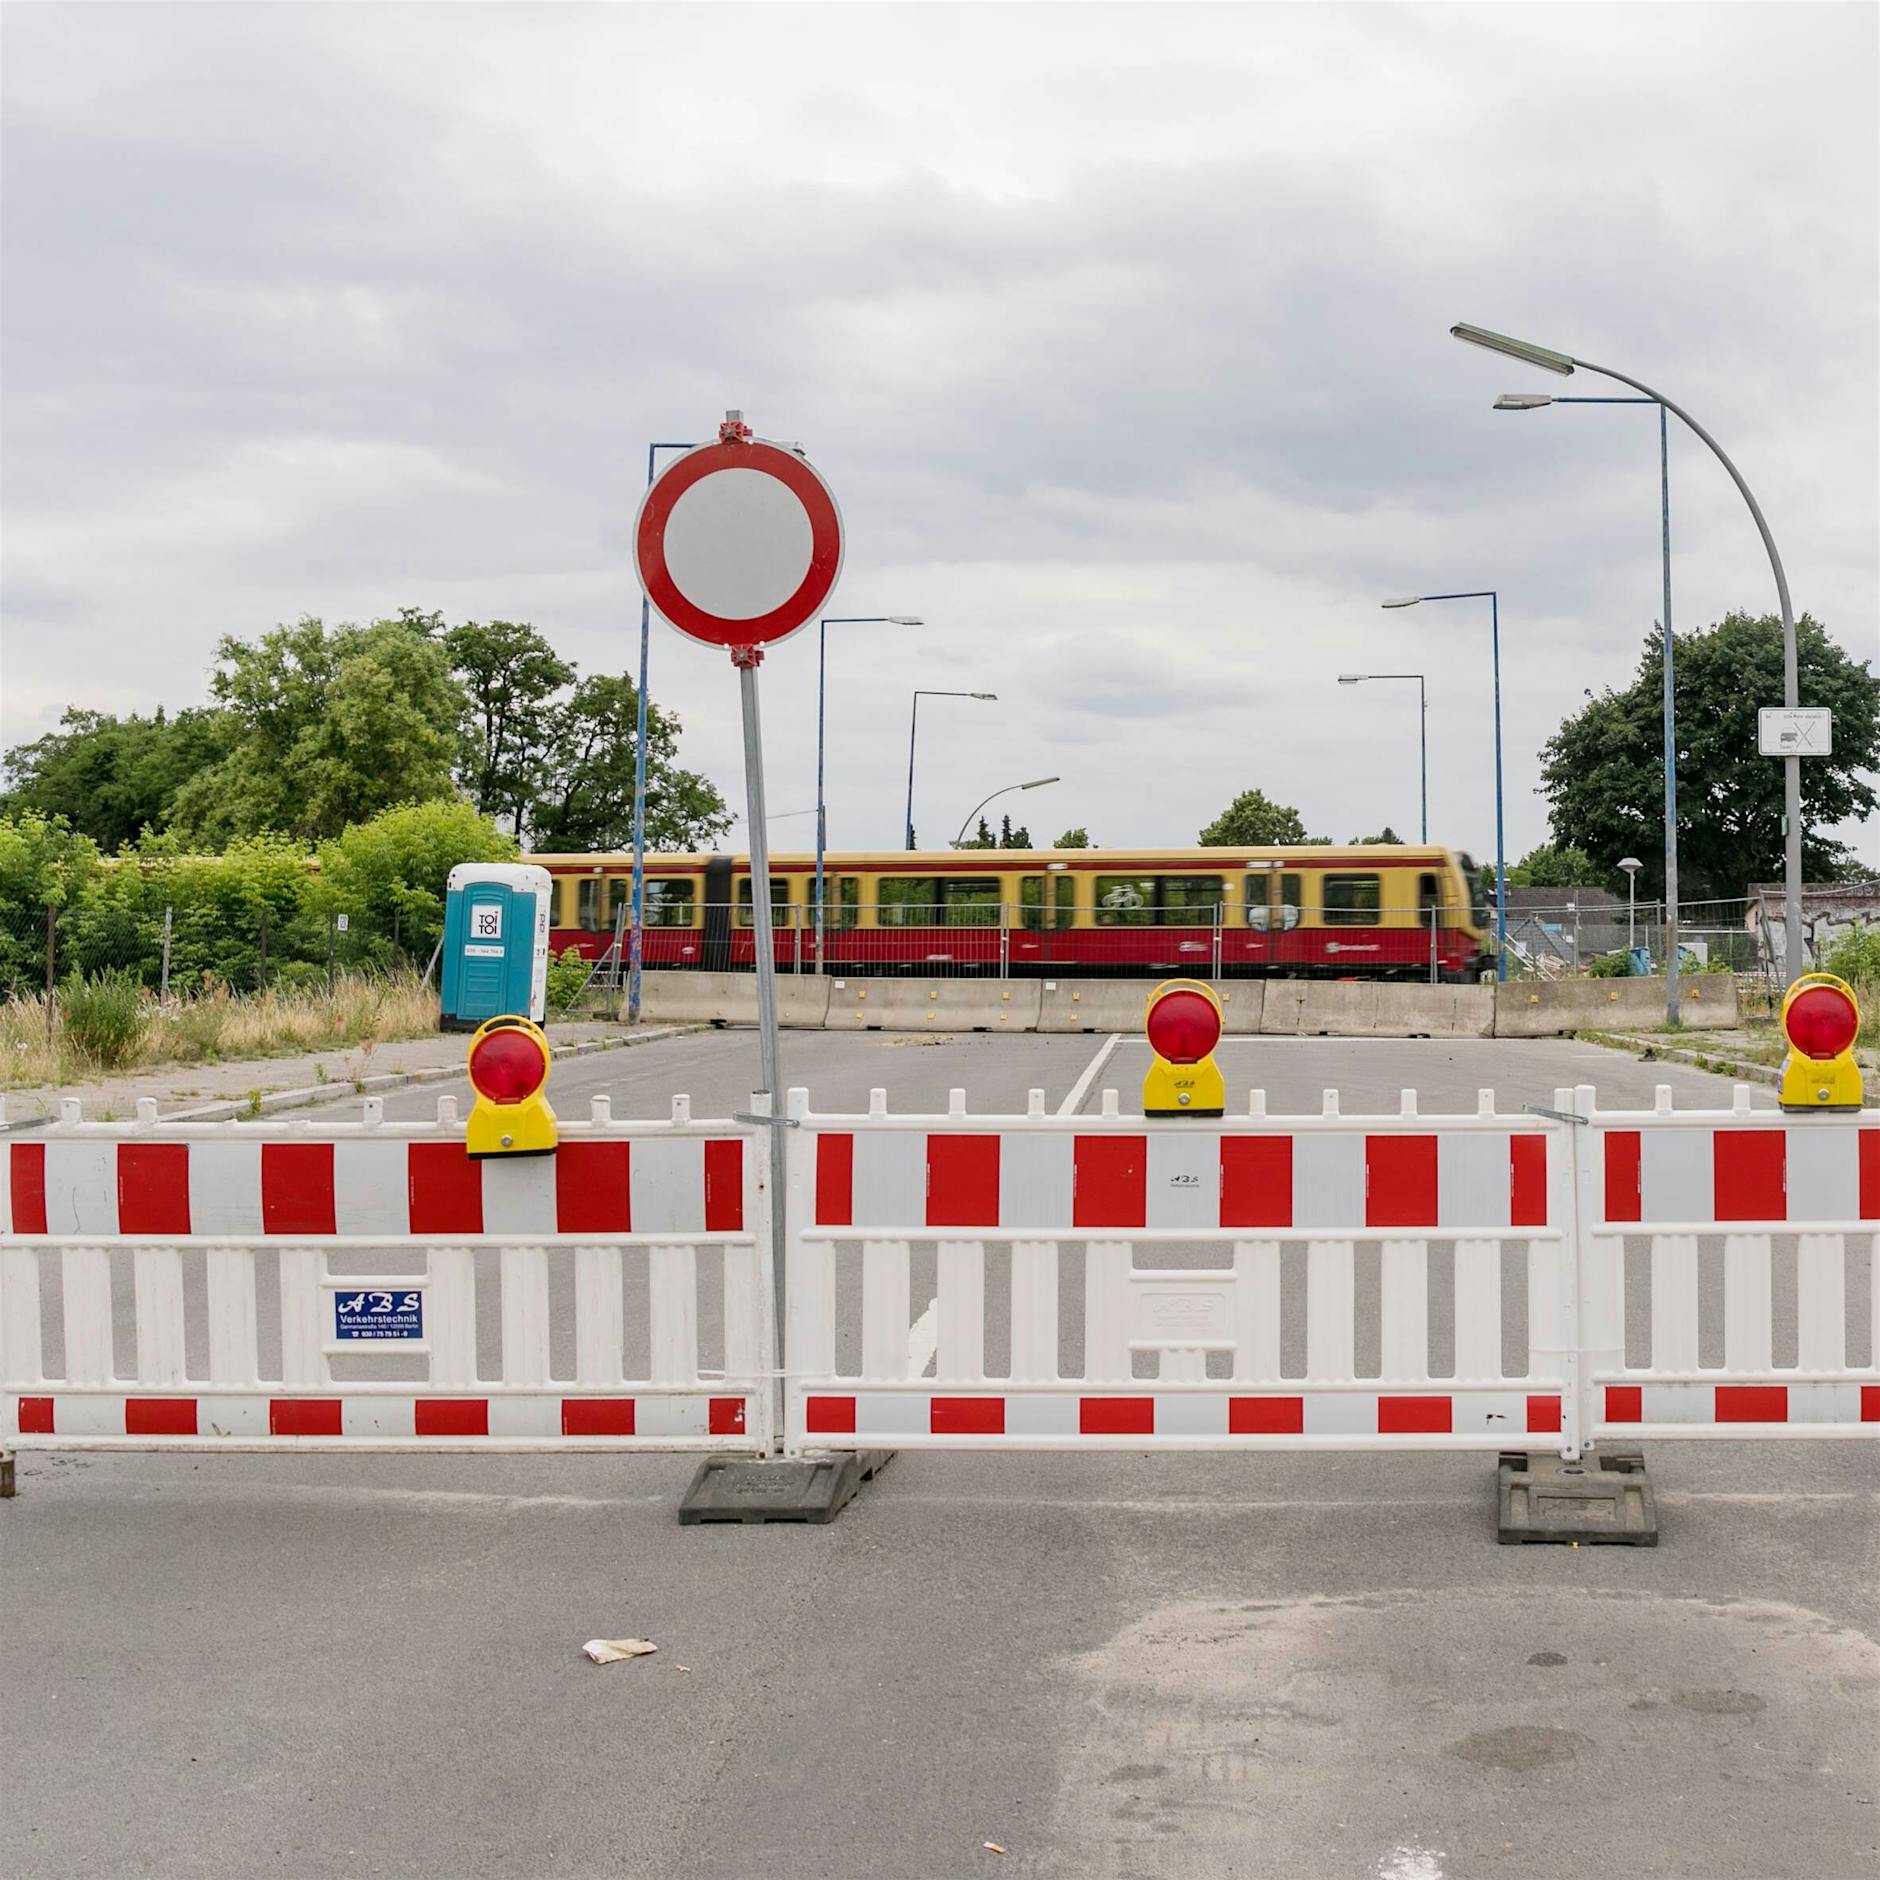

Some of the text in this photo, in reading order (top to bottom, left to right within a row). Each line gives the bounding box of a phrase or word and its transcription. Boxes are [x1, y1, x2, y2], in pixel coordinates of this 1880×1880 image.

[479, 925, 497, 935] TOI
[338, 1292, 419, 1313] ABS
[340, 1314, 418, 1323] Verkehrstechnik
